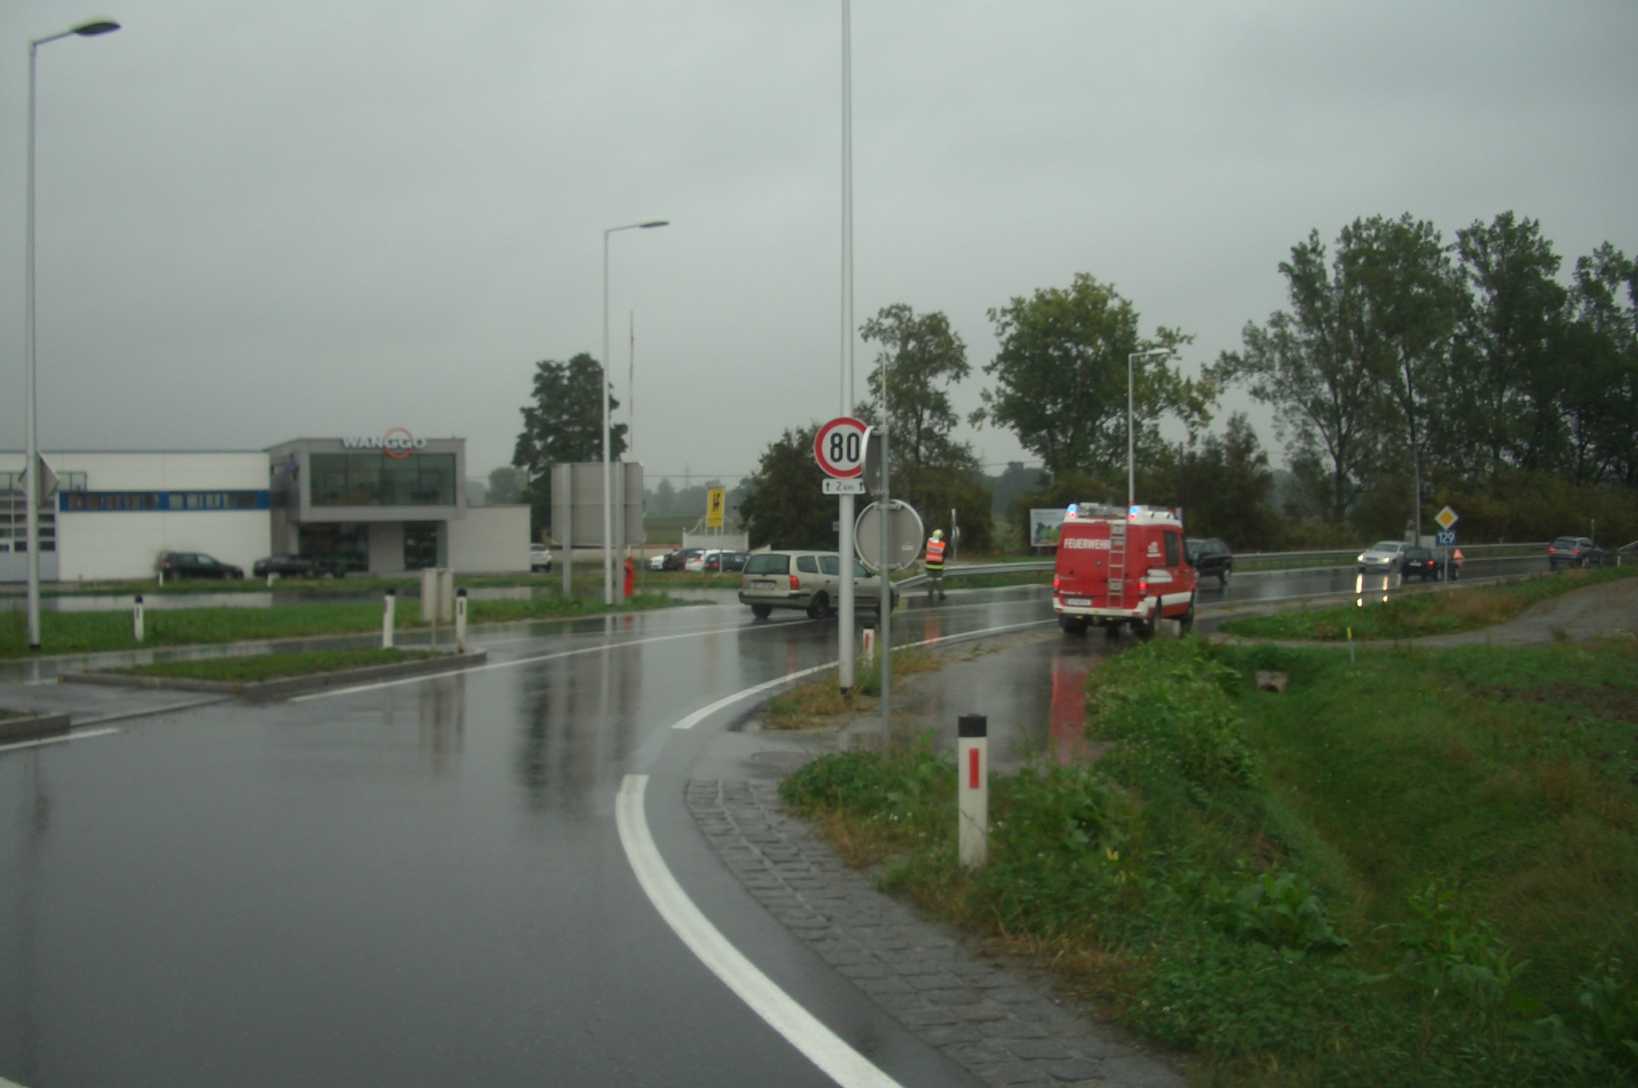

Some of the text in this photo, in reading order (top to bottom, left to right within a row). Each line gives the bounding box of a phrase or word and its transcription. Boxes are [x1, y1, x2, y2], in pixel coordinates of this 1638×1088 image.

[830, 432, 860, 463] 80
[835, 481, 843, 491] 2
[1438, 532, 1456, 544] 129
